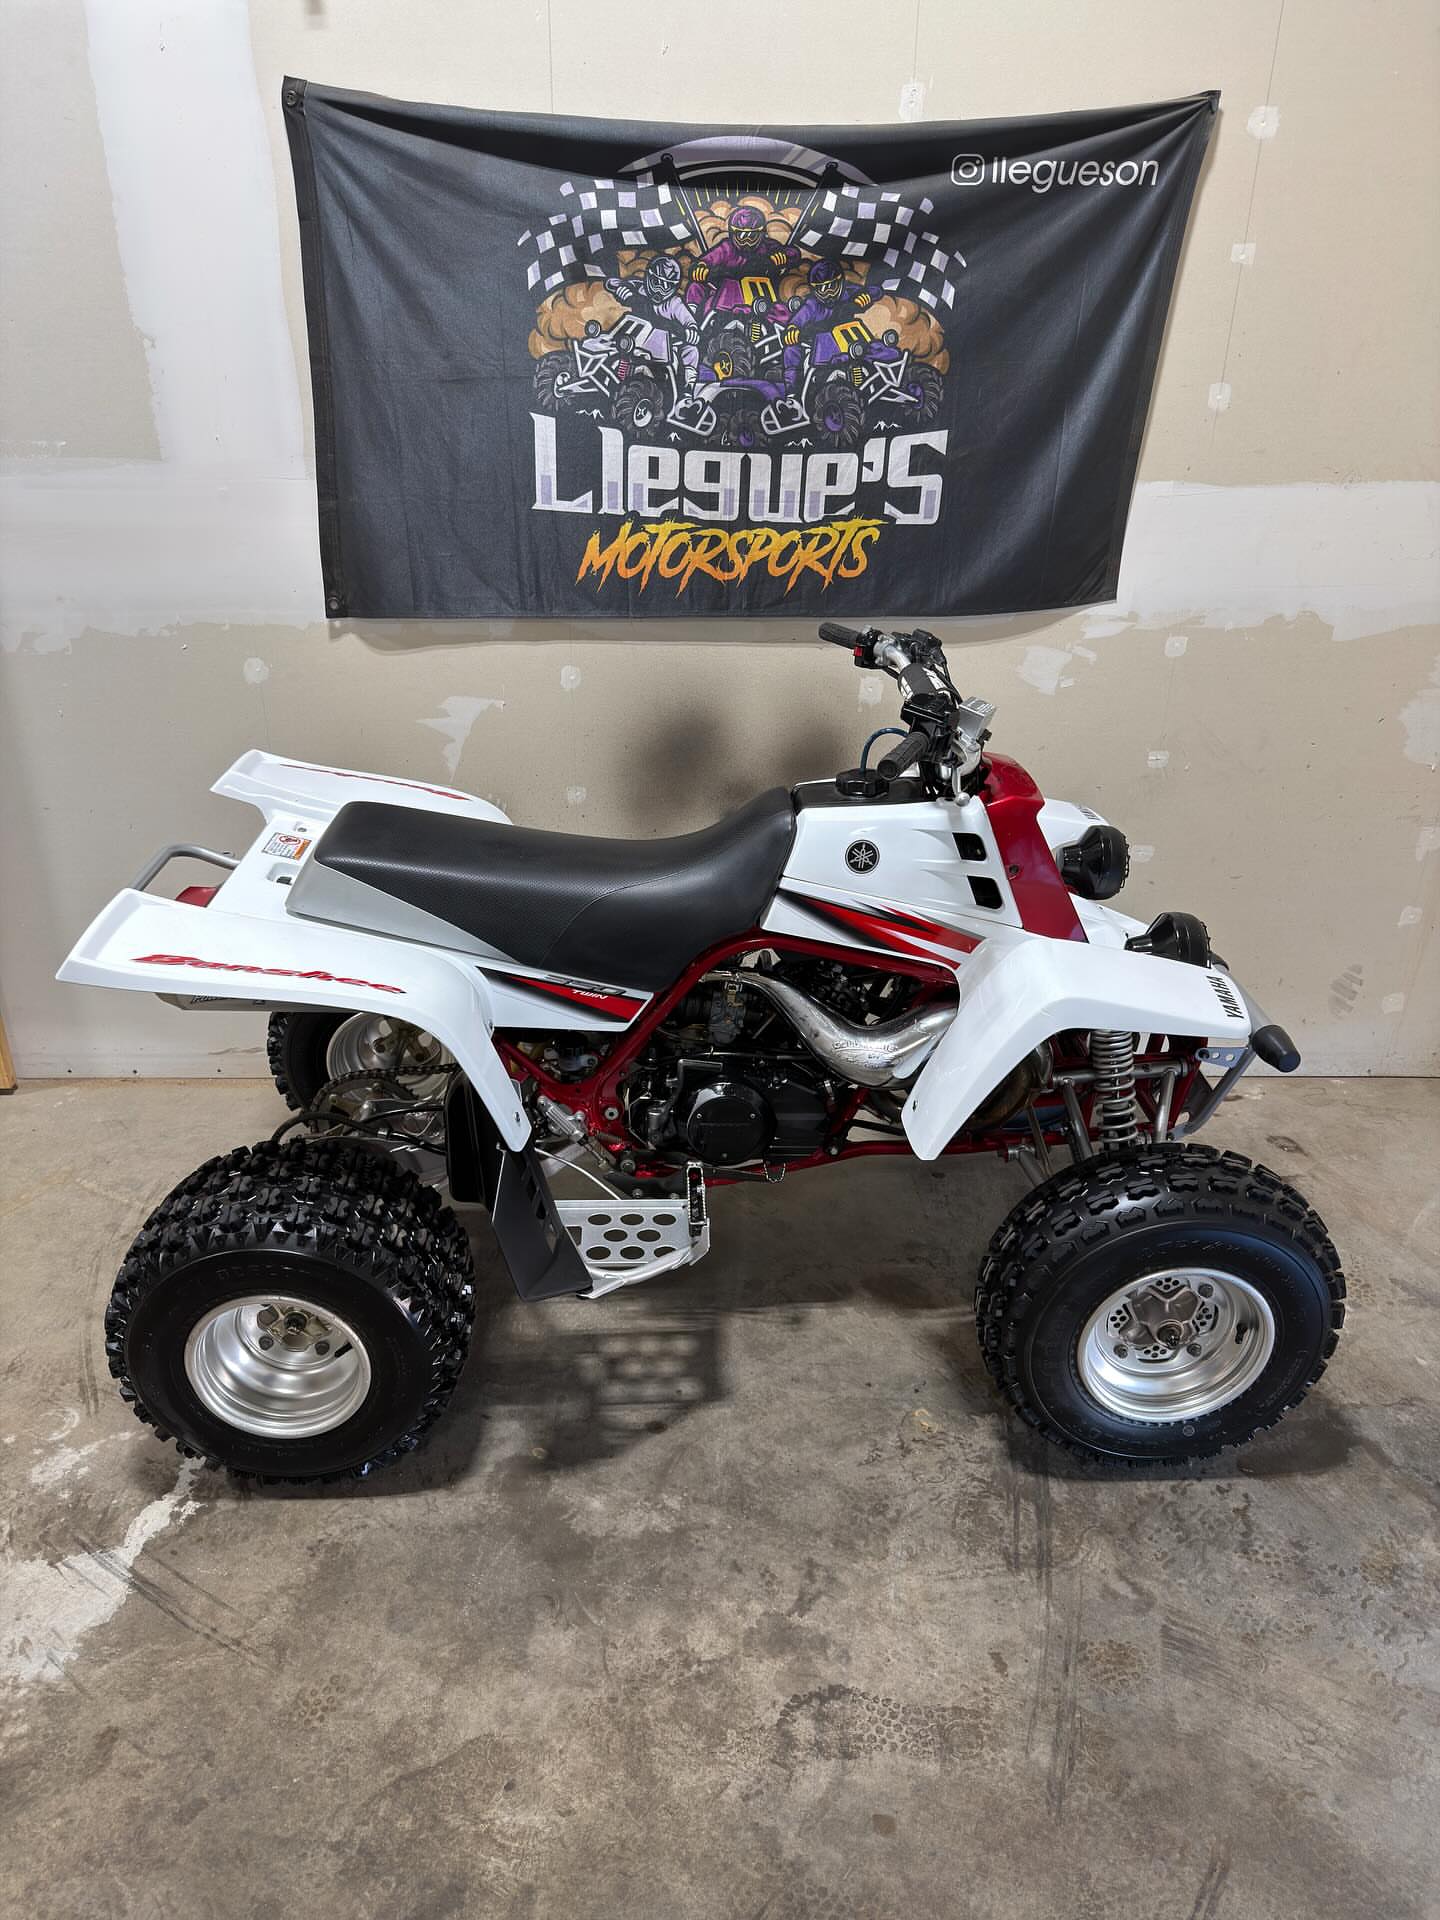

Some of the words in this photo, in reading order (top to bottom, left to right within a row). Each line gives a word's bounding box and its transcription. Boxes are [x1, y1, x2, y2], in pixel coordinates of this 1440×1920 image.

[575, 516, 888, 599] MOTORSPORTS
[572, 988, 609, 1000] TWIN
[1206, 975, 1245, 1019] YAMAHA
